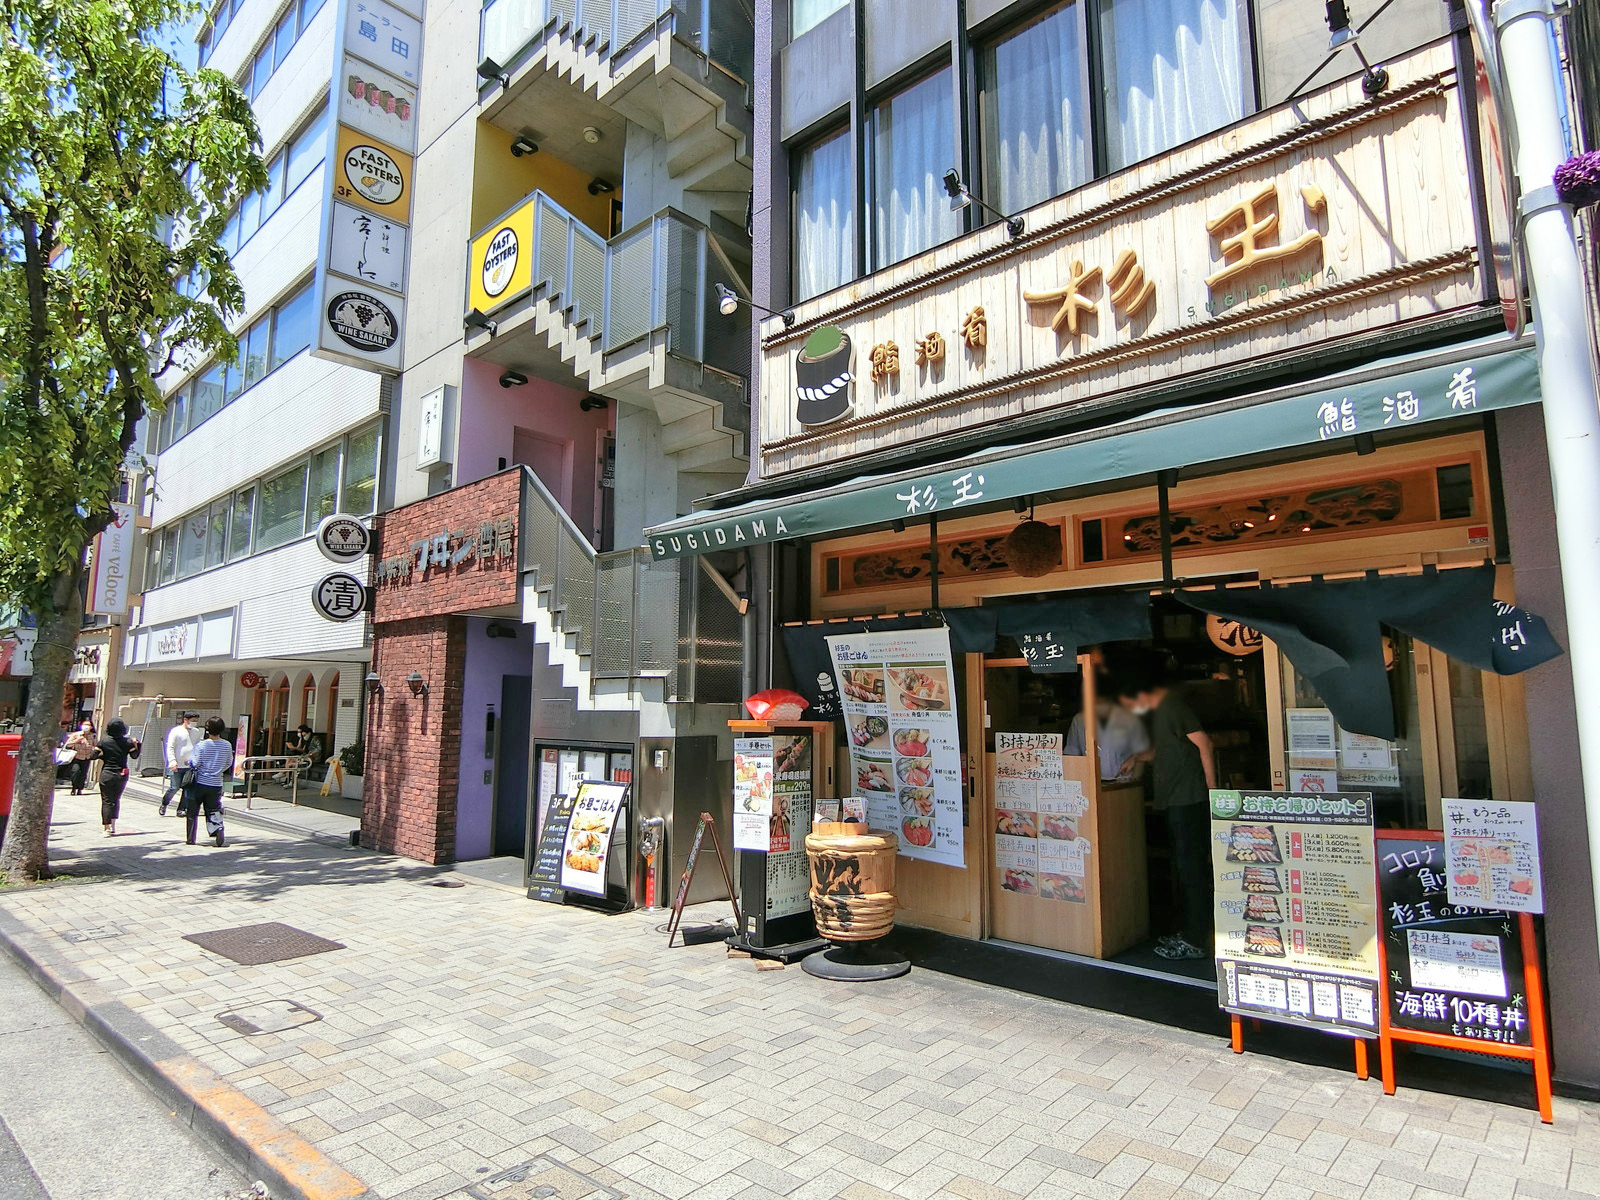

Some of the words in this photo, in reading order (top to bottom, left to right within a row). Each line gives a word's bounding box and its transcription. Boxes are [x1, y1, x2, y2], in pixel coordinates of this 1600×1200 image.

[357, 3, 402, 32] テーラー
[358, 19, 409, 59] 島田
[361, 149, 391, 169] FAST
[347, 156, 401, 186] OYSTERS
[337, 185, 352, 198] 3F
[492, 232, 511, 254] FAST
[484, 243, 517, 272] OYSTERS
[1022, 182, 1328, 336] 杉玉
[1187, 265, 1337, 318] SUGIDAMA
[337, 324, 358, 337] WINE
[359, 331, 388, 346] SAKABA
[1316, 366, 1478, 439] 鮨酒肴
[896, 471, 985, 514] 杉玉
[655, 515, 789, 556] SUGIDAMA
[103, 556, 124, 608] veloce
[325, 581, 358, 611] 漬
[836, 651, 869, 661] お昼ごはん
[1019, 643, 1065, 661] 杉玉
[999, 734, 1058, 751] お持ち帰り
[571, 773, 584, 781] TAKE
[551, 797, 562, 808] 3F
[579, 797, 616, 813] お昼ごはん
[1242, 796, 1356, 815] お持ち帰りセット
[1473, 806, 1511, 819] もう一品
[1452, 827, 1495, 837] お持ち帰り
[1293, 841, 1301, 849] 上
[1410, 931, 1451, 945] 寿司弁当
[1395, 990, 1526, 1030] 海鮮10種丼
[1451, 1023, 1515, 1043] もあります!!
